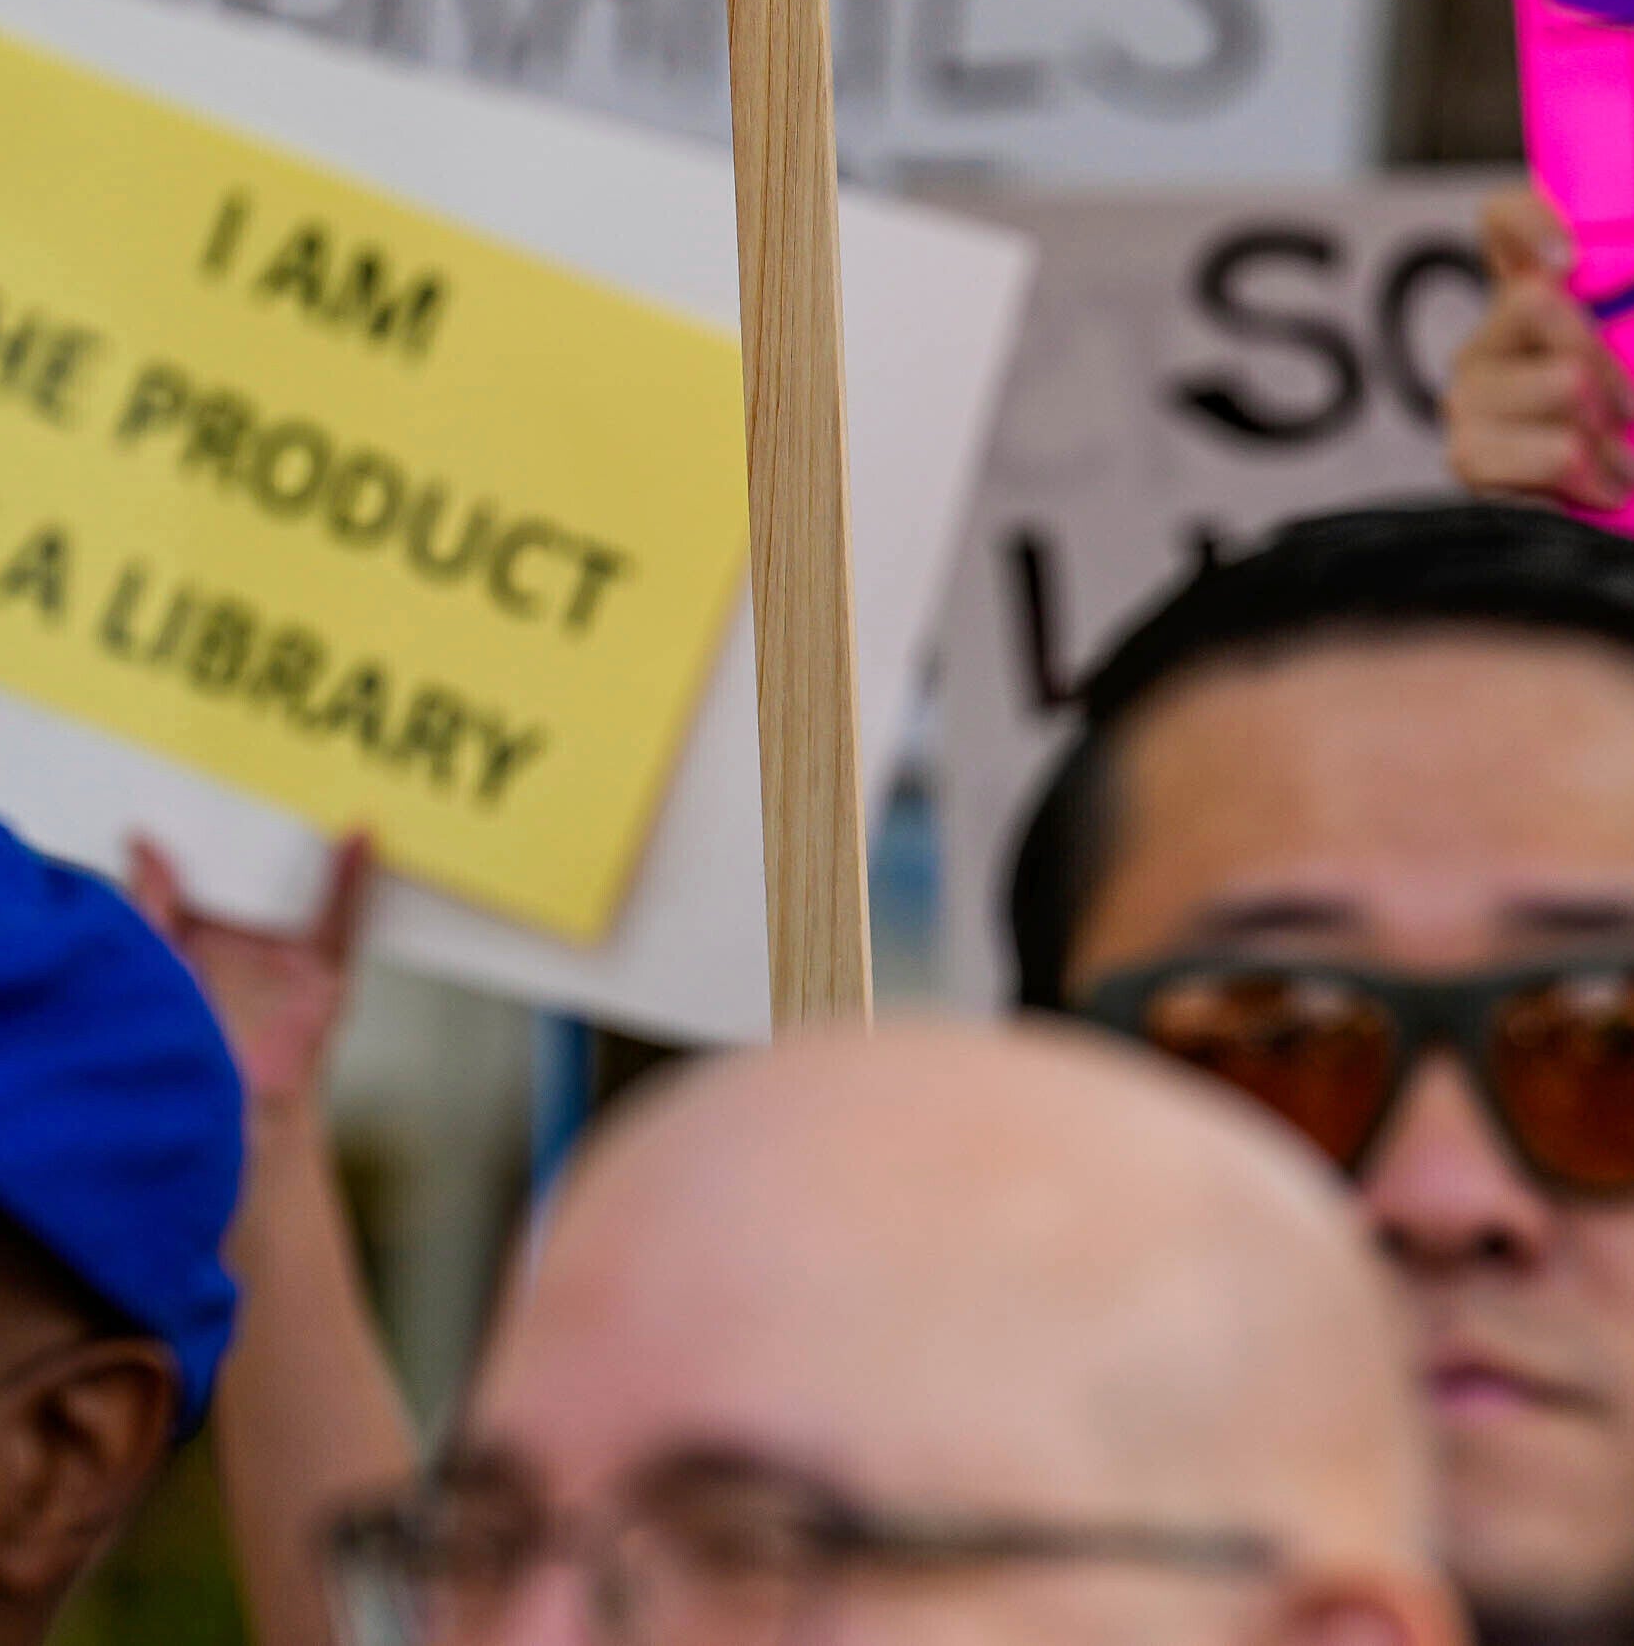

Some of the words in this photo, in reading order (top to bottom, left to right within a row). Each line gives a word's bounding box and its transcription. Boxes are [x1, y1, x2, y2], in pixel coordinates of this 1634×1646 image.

[199, 184, 251, 284] I
[253, 217, 452, 371] AM
[110, 354, 639, 646] PRODUCT
[92, 554, 551, 819] LIBRARY
